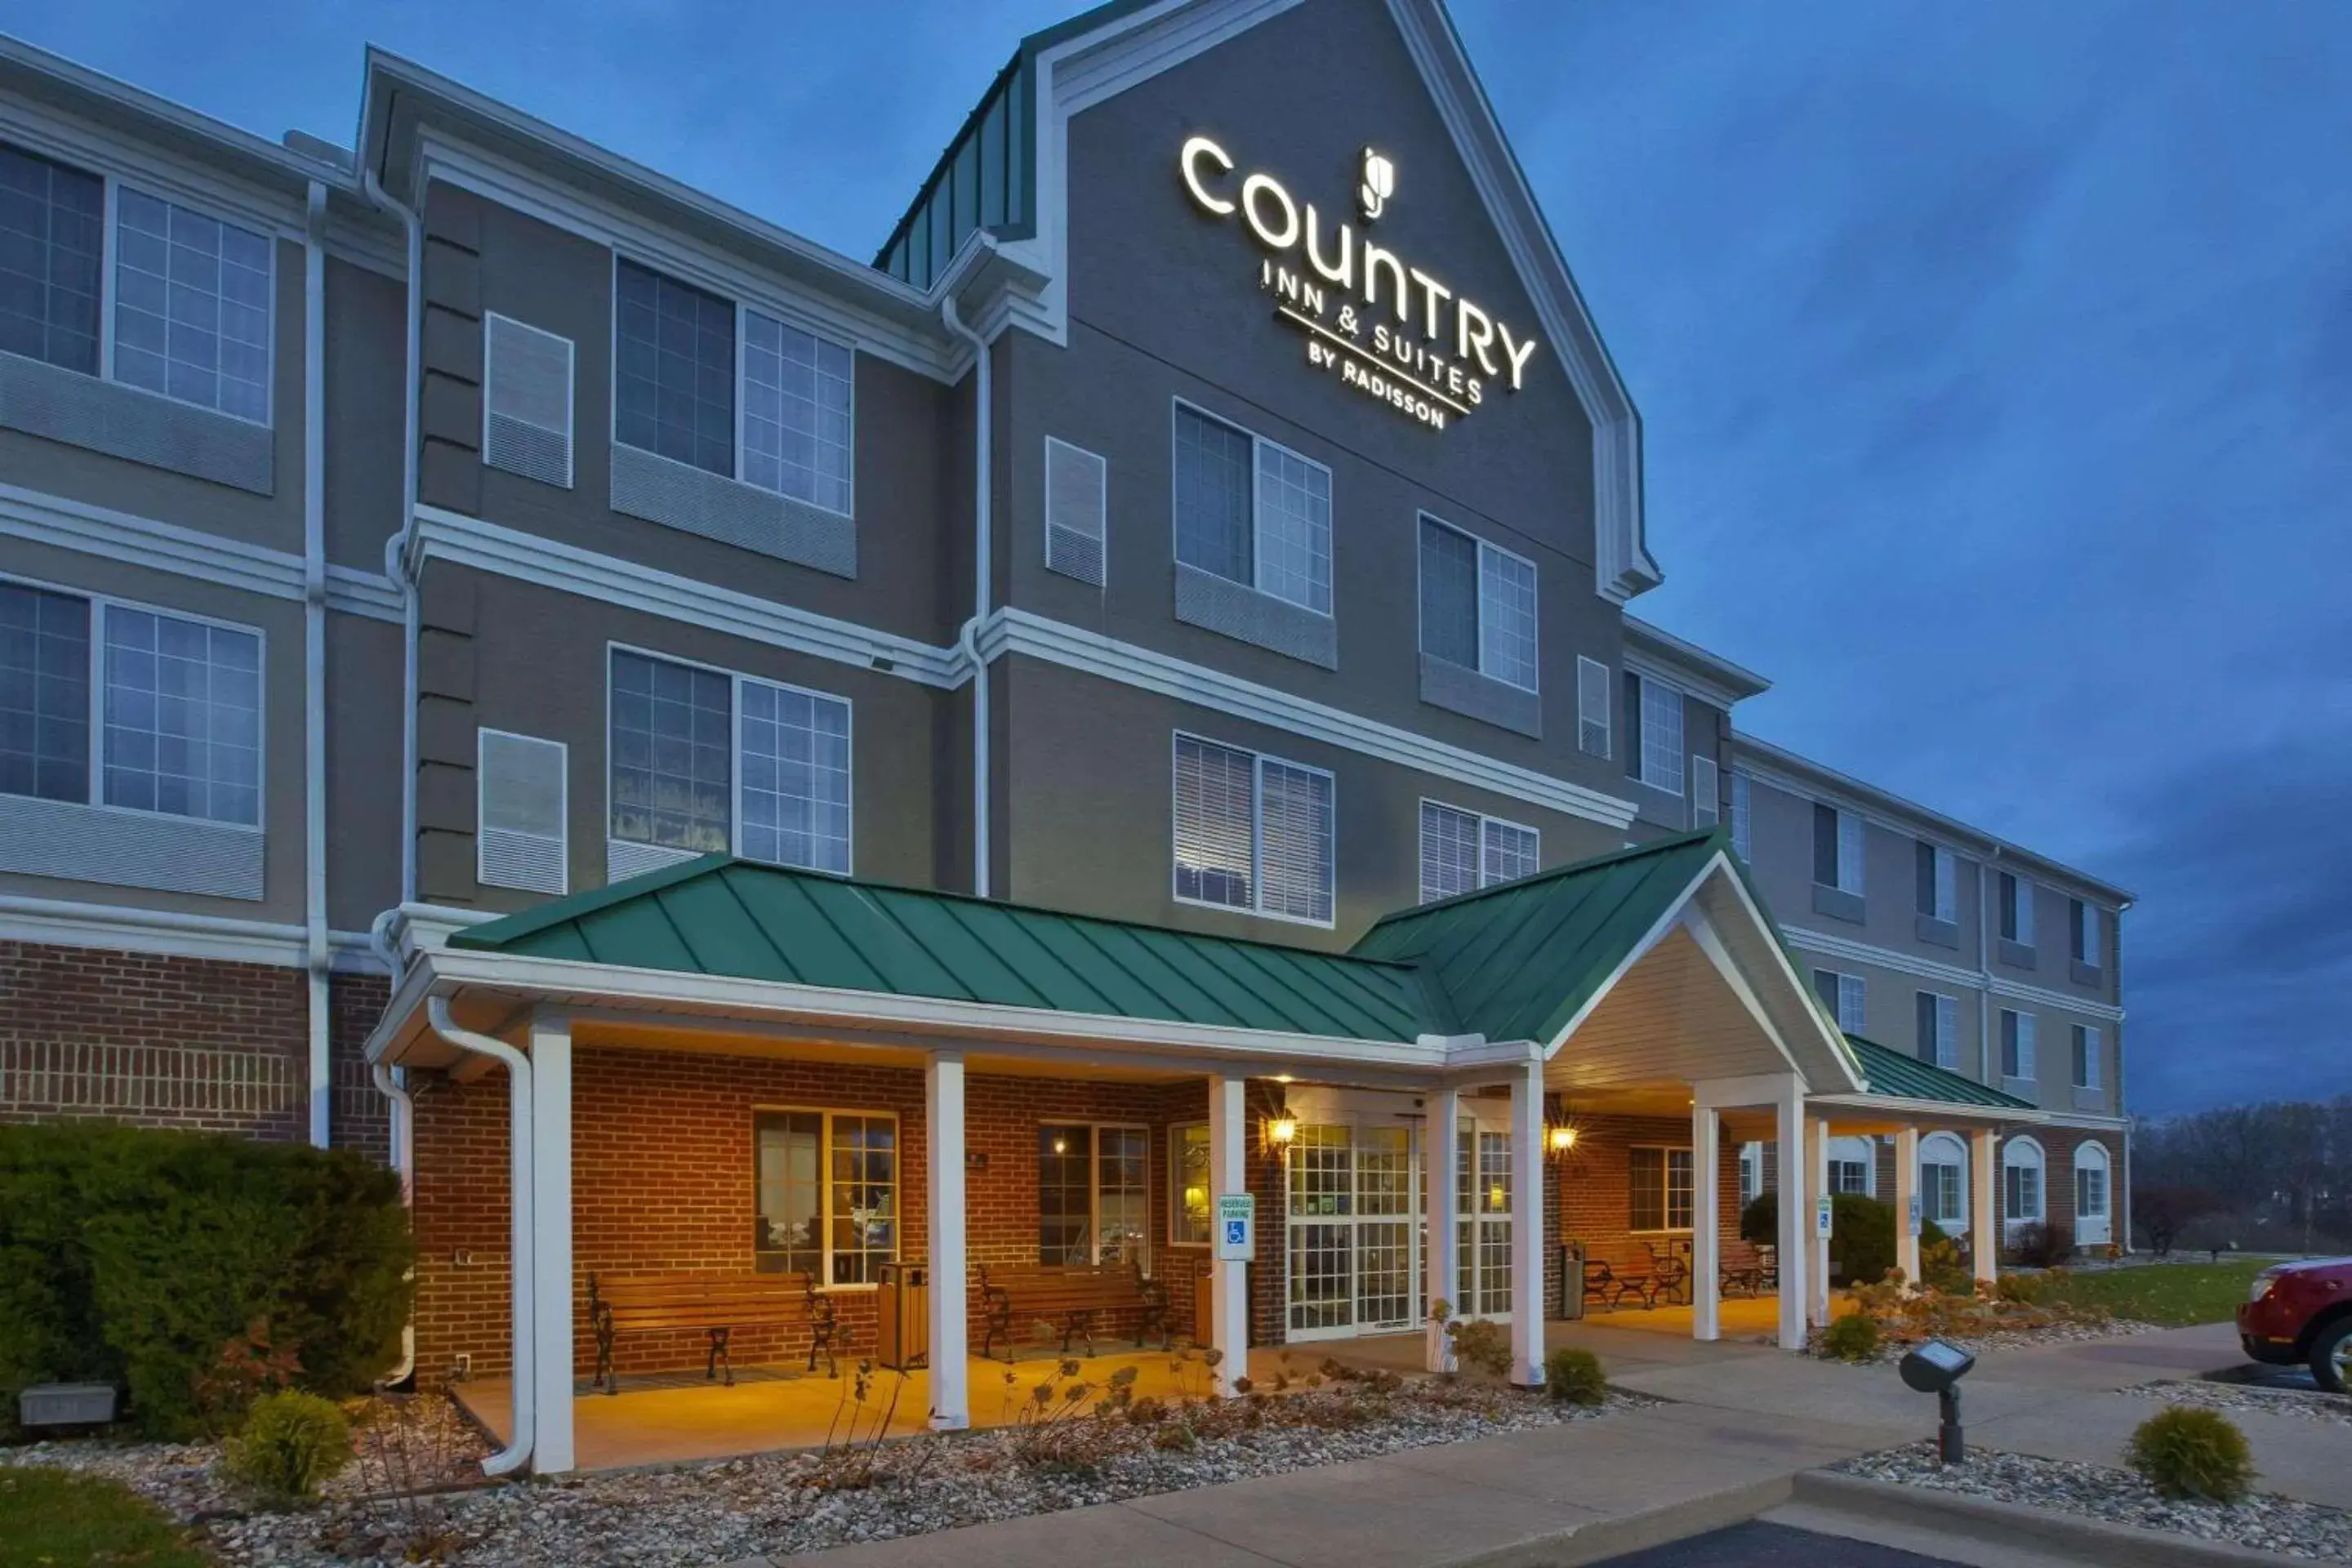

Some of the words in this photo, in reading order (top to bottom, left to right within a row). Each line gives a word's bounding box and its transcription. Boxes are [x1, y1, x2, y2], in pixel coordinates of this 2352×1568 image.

[1262, 260, 1324, 315] INN
[1339, 305, 1359, 334] &
[1374, 324, 1482, 405] SUITES
[1308, 341, 1336, 369] BY
[1343, 363, 1446, 429] RADISSON
